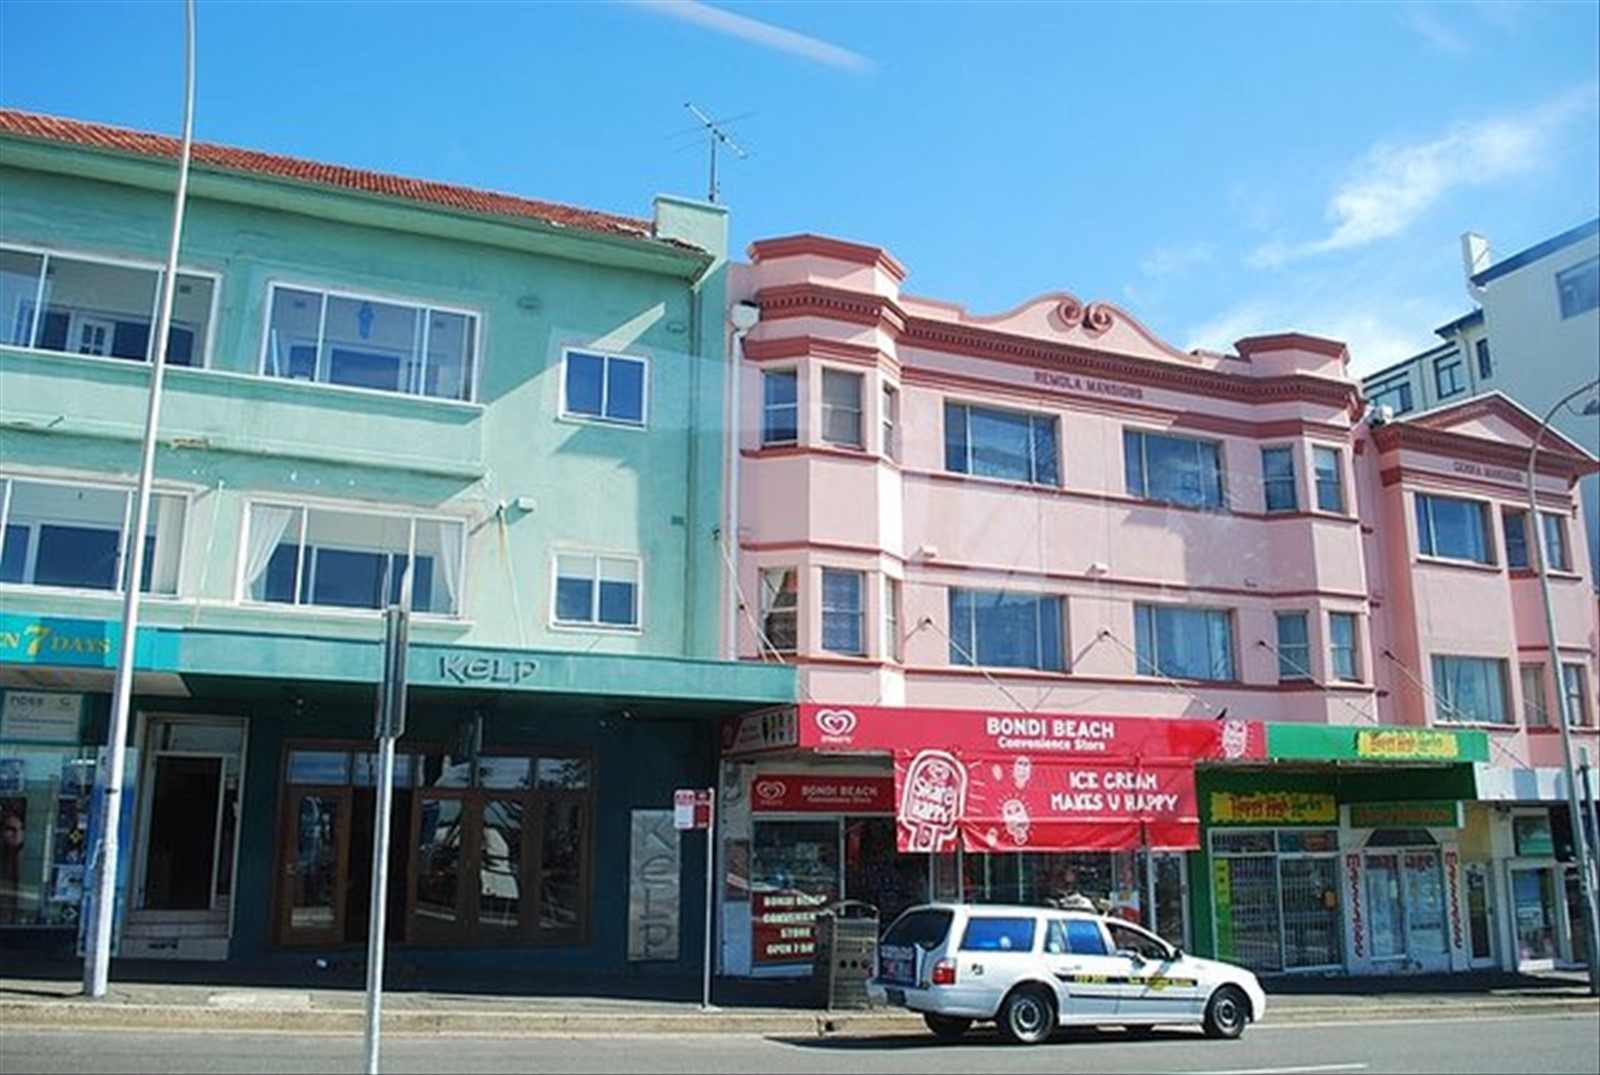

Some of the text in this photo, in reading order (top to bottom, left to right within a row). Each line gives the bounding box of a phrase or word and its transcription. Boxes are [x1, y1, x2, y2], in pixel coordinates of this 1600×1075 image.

[0, 624, 111, 655] N 7 DAYS
[440, 656, 537, 684] KELP
[986, 717, 1114, 738] BONDI BEACH
[998, 737, 1105, 751] Convenience Store
[1069, 771, 1157, 790] ICE CREAM
[801, 785, 878, 798] BONDI BEACH
[1051, 793, 1178, 811] MAKES U HAPPY
[781, 928, 810, 938] STORE
[766, 944, 792, 954] OPEN
